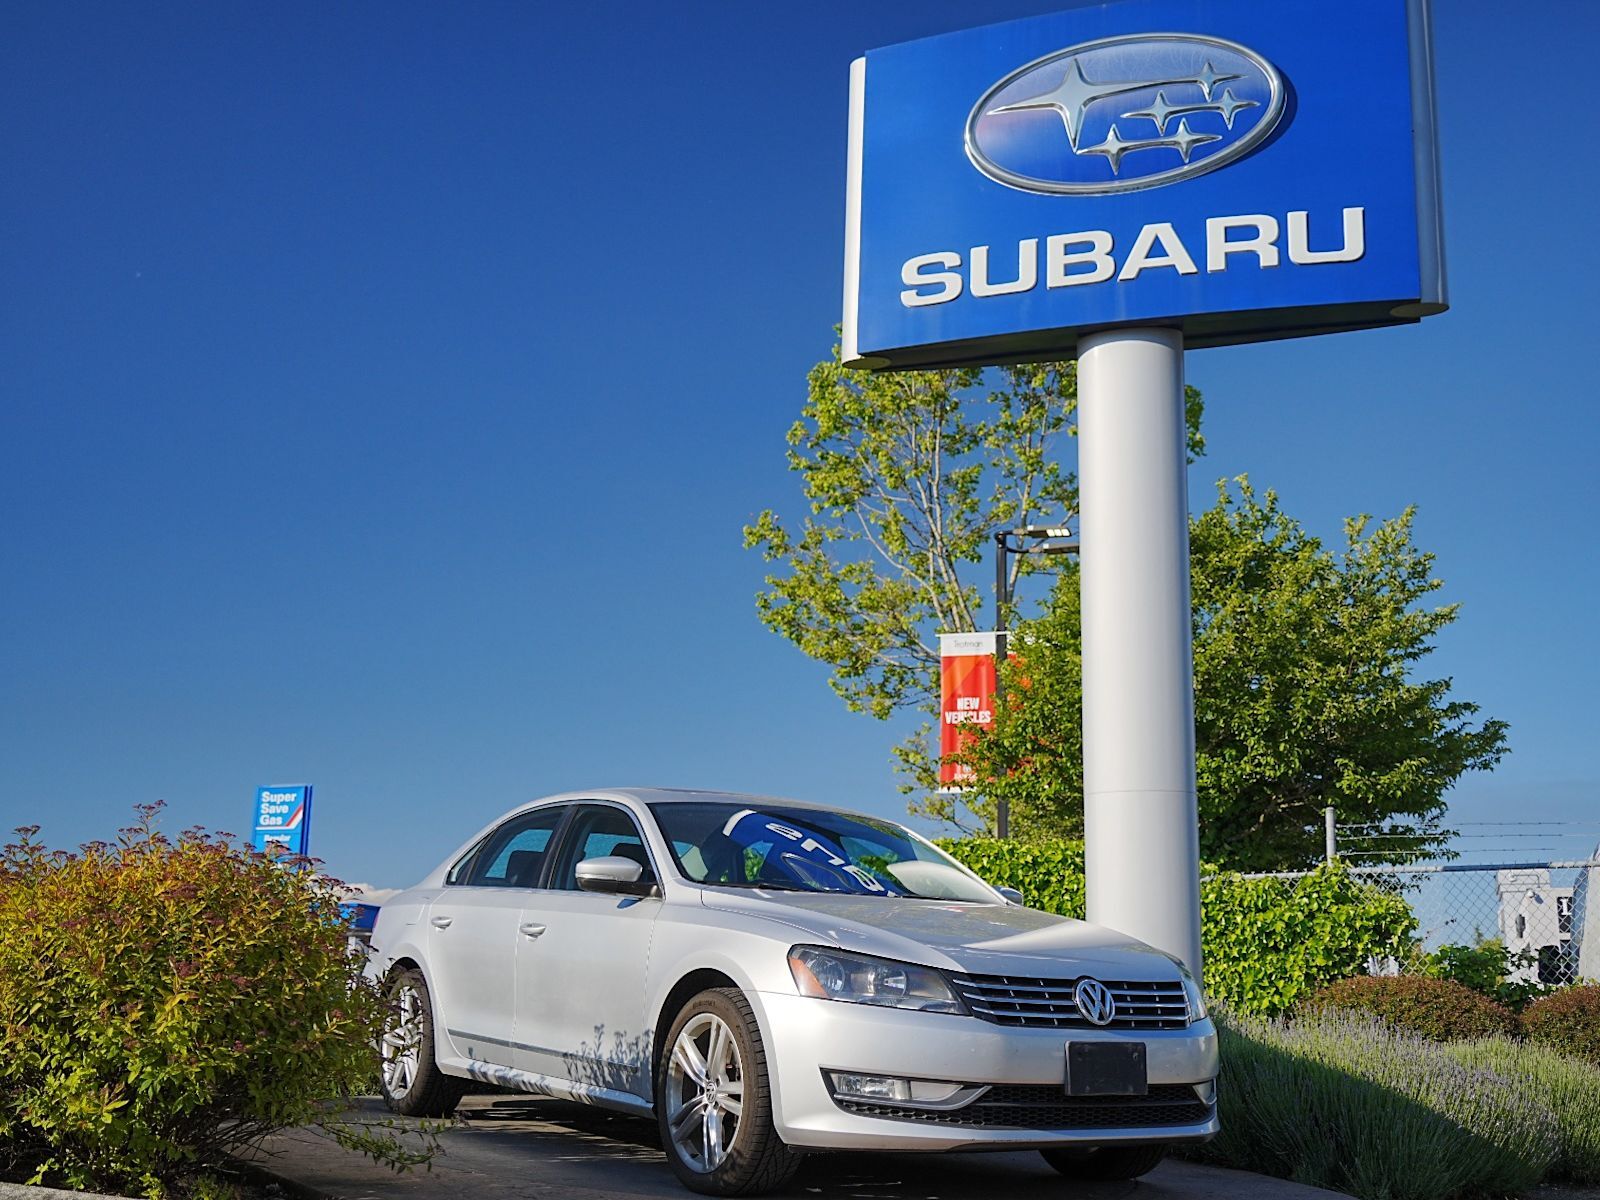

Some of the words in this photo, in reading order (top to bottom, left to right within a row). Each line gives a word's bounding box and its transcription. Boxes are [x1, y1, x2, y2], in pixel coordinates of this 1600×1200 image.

[901, 207, 1365, 308] SUBARU
[957, 697, 980, 710] NEW
[261, 791, 296, 803] Super
[260, 803, 288, 815] Save
[259, 815, 282, 826] Gas
